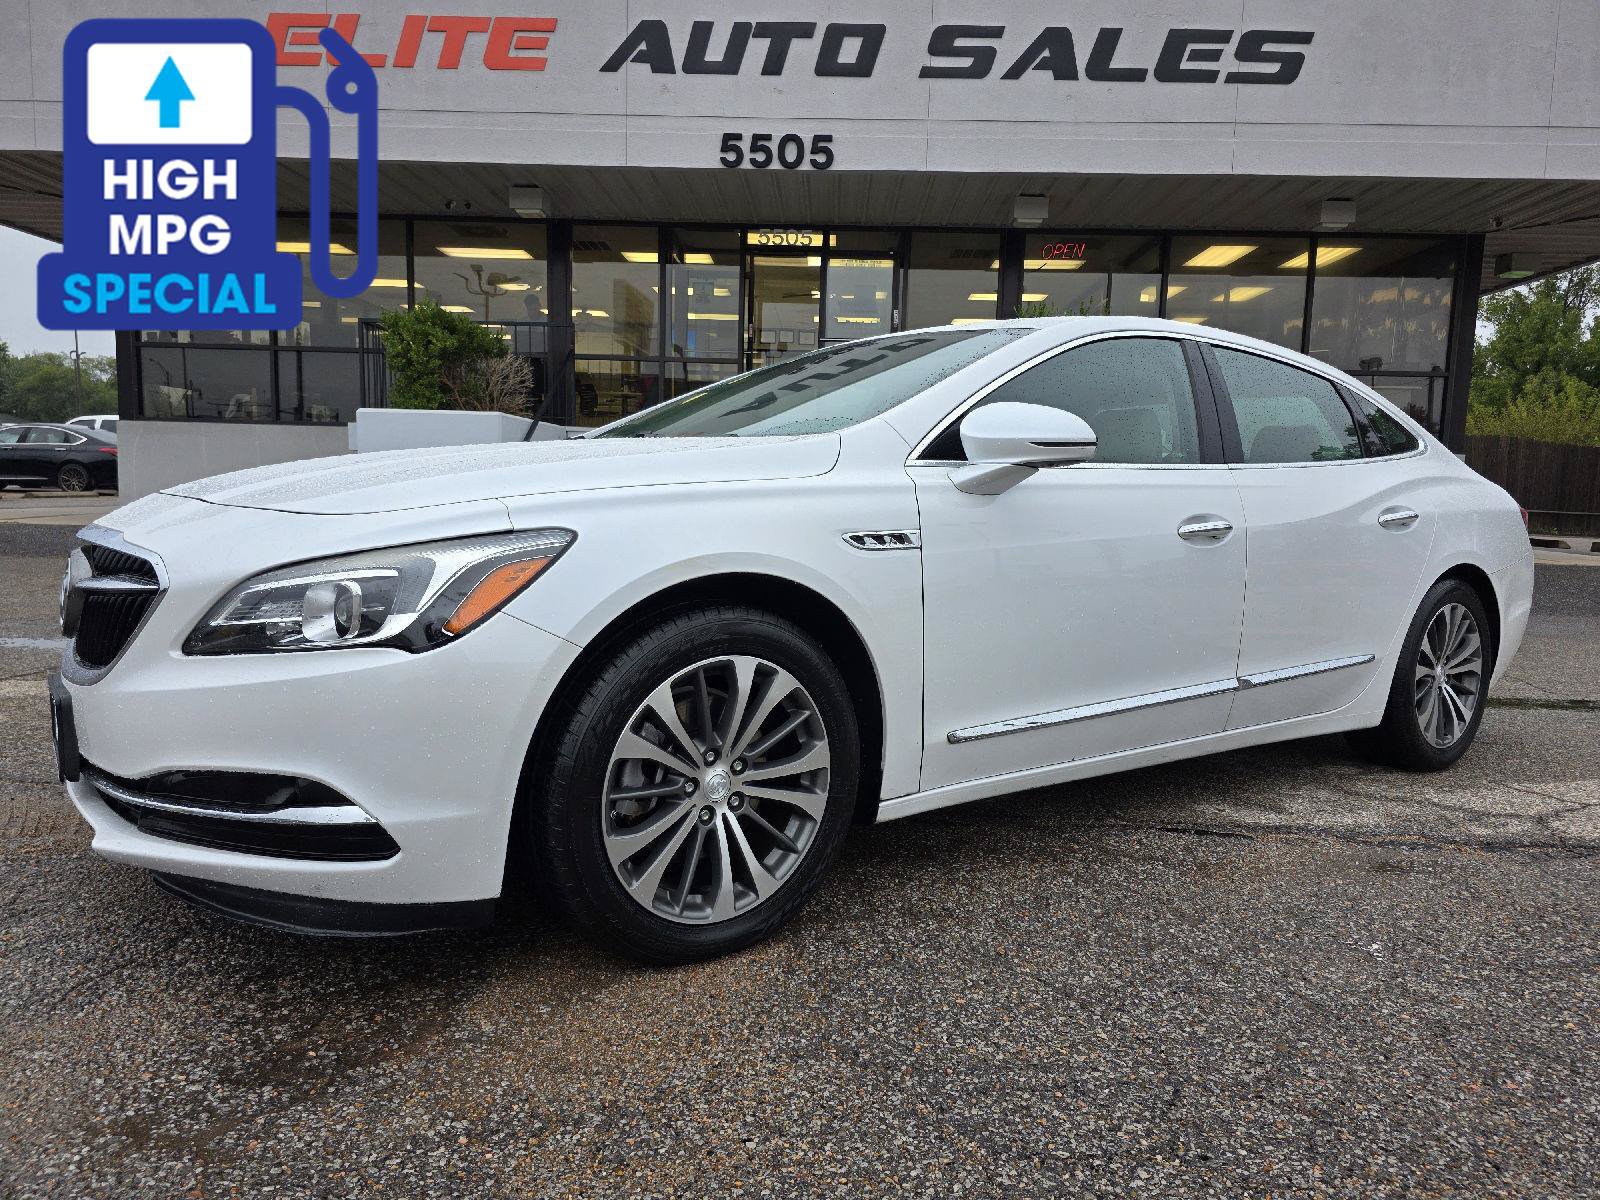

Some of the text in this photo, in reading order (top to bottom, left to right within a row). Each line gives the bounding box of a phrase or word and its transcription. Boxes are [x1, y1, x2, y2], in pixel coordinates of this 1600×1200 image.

[267, 13, 1314, 84] ELITE AUTO SALES
[720, 132, 834, 170] 5505
[758, 229, 813, 246] 5505
[1042, 243, 1086, 259] OPEN
